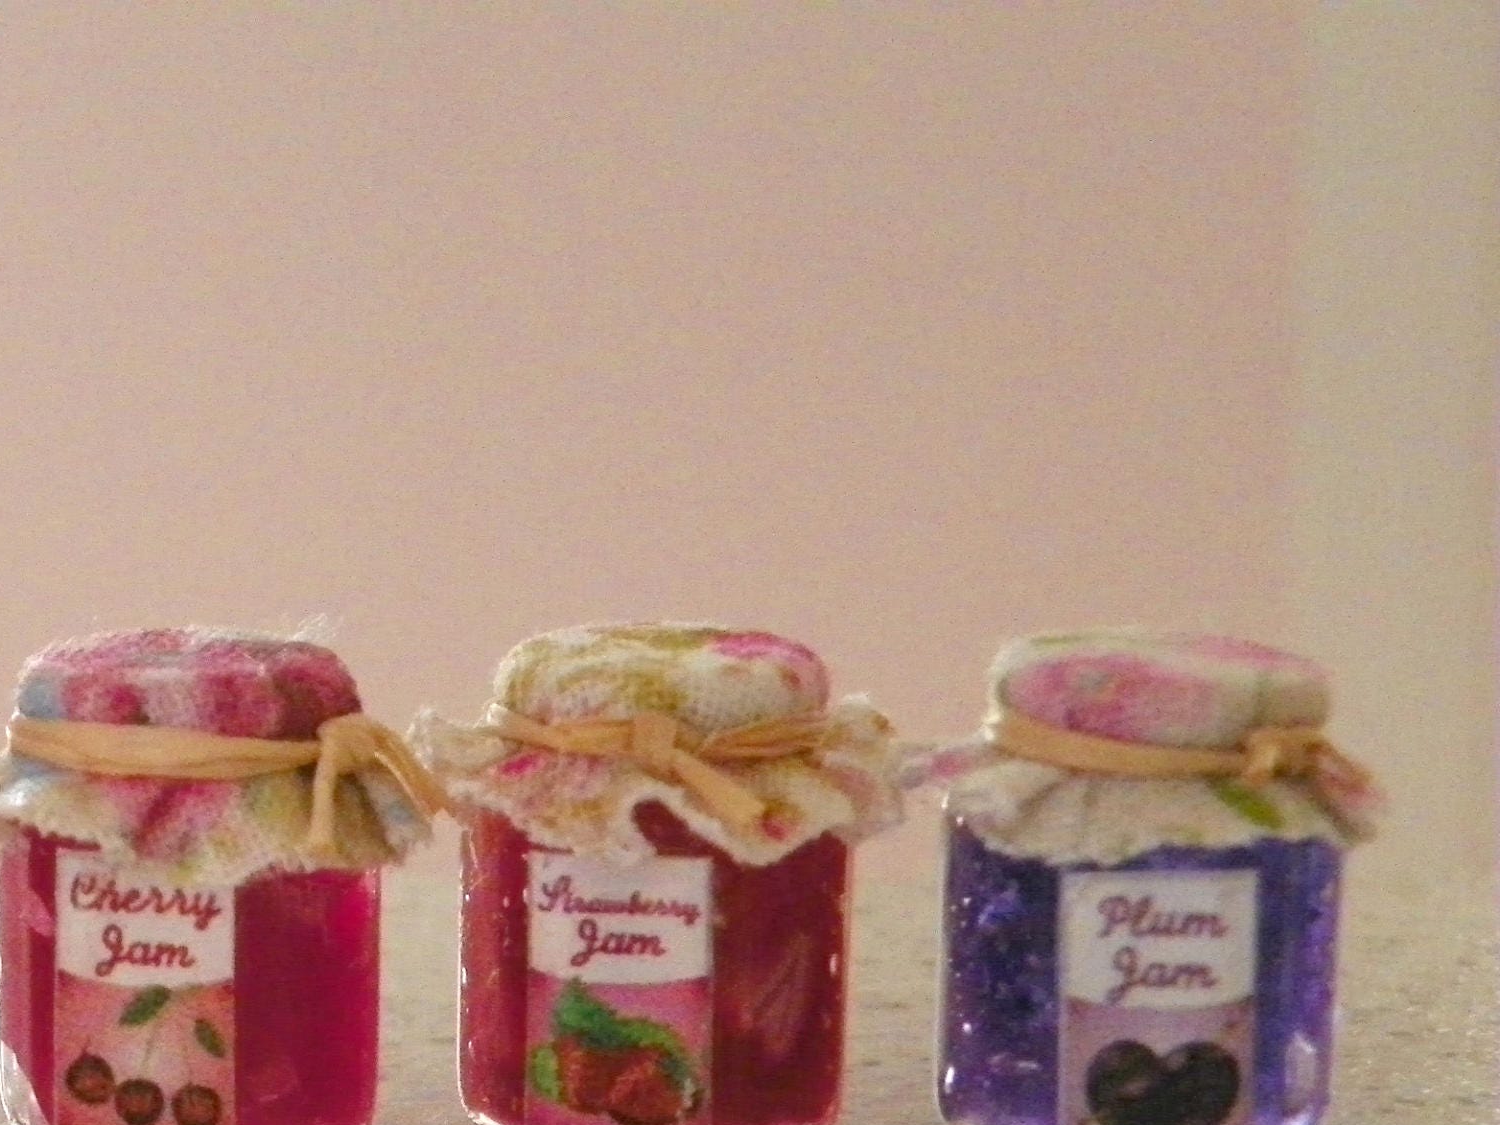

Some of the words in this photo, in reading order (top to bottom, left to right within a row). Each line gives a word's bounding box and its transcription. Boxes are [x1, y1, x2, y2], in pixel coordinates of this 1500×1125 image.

[70, 872, 222, 931] Cherry
[1097, 895, 1230, 939] Plum
[94, 923, 196, 978] Jam
[570, 918, 667, 967] Jam
[1103, 945, 1219, 1007] Jam
